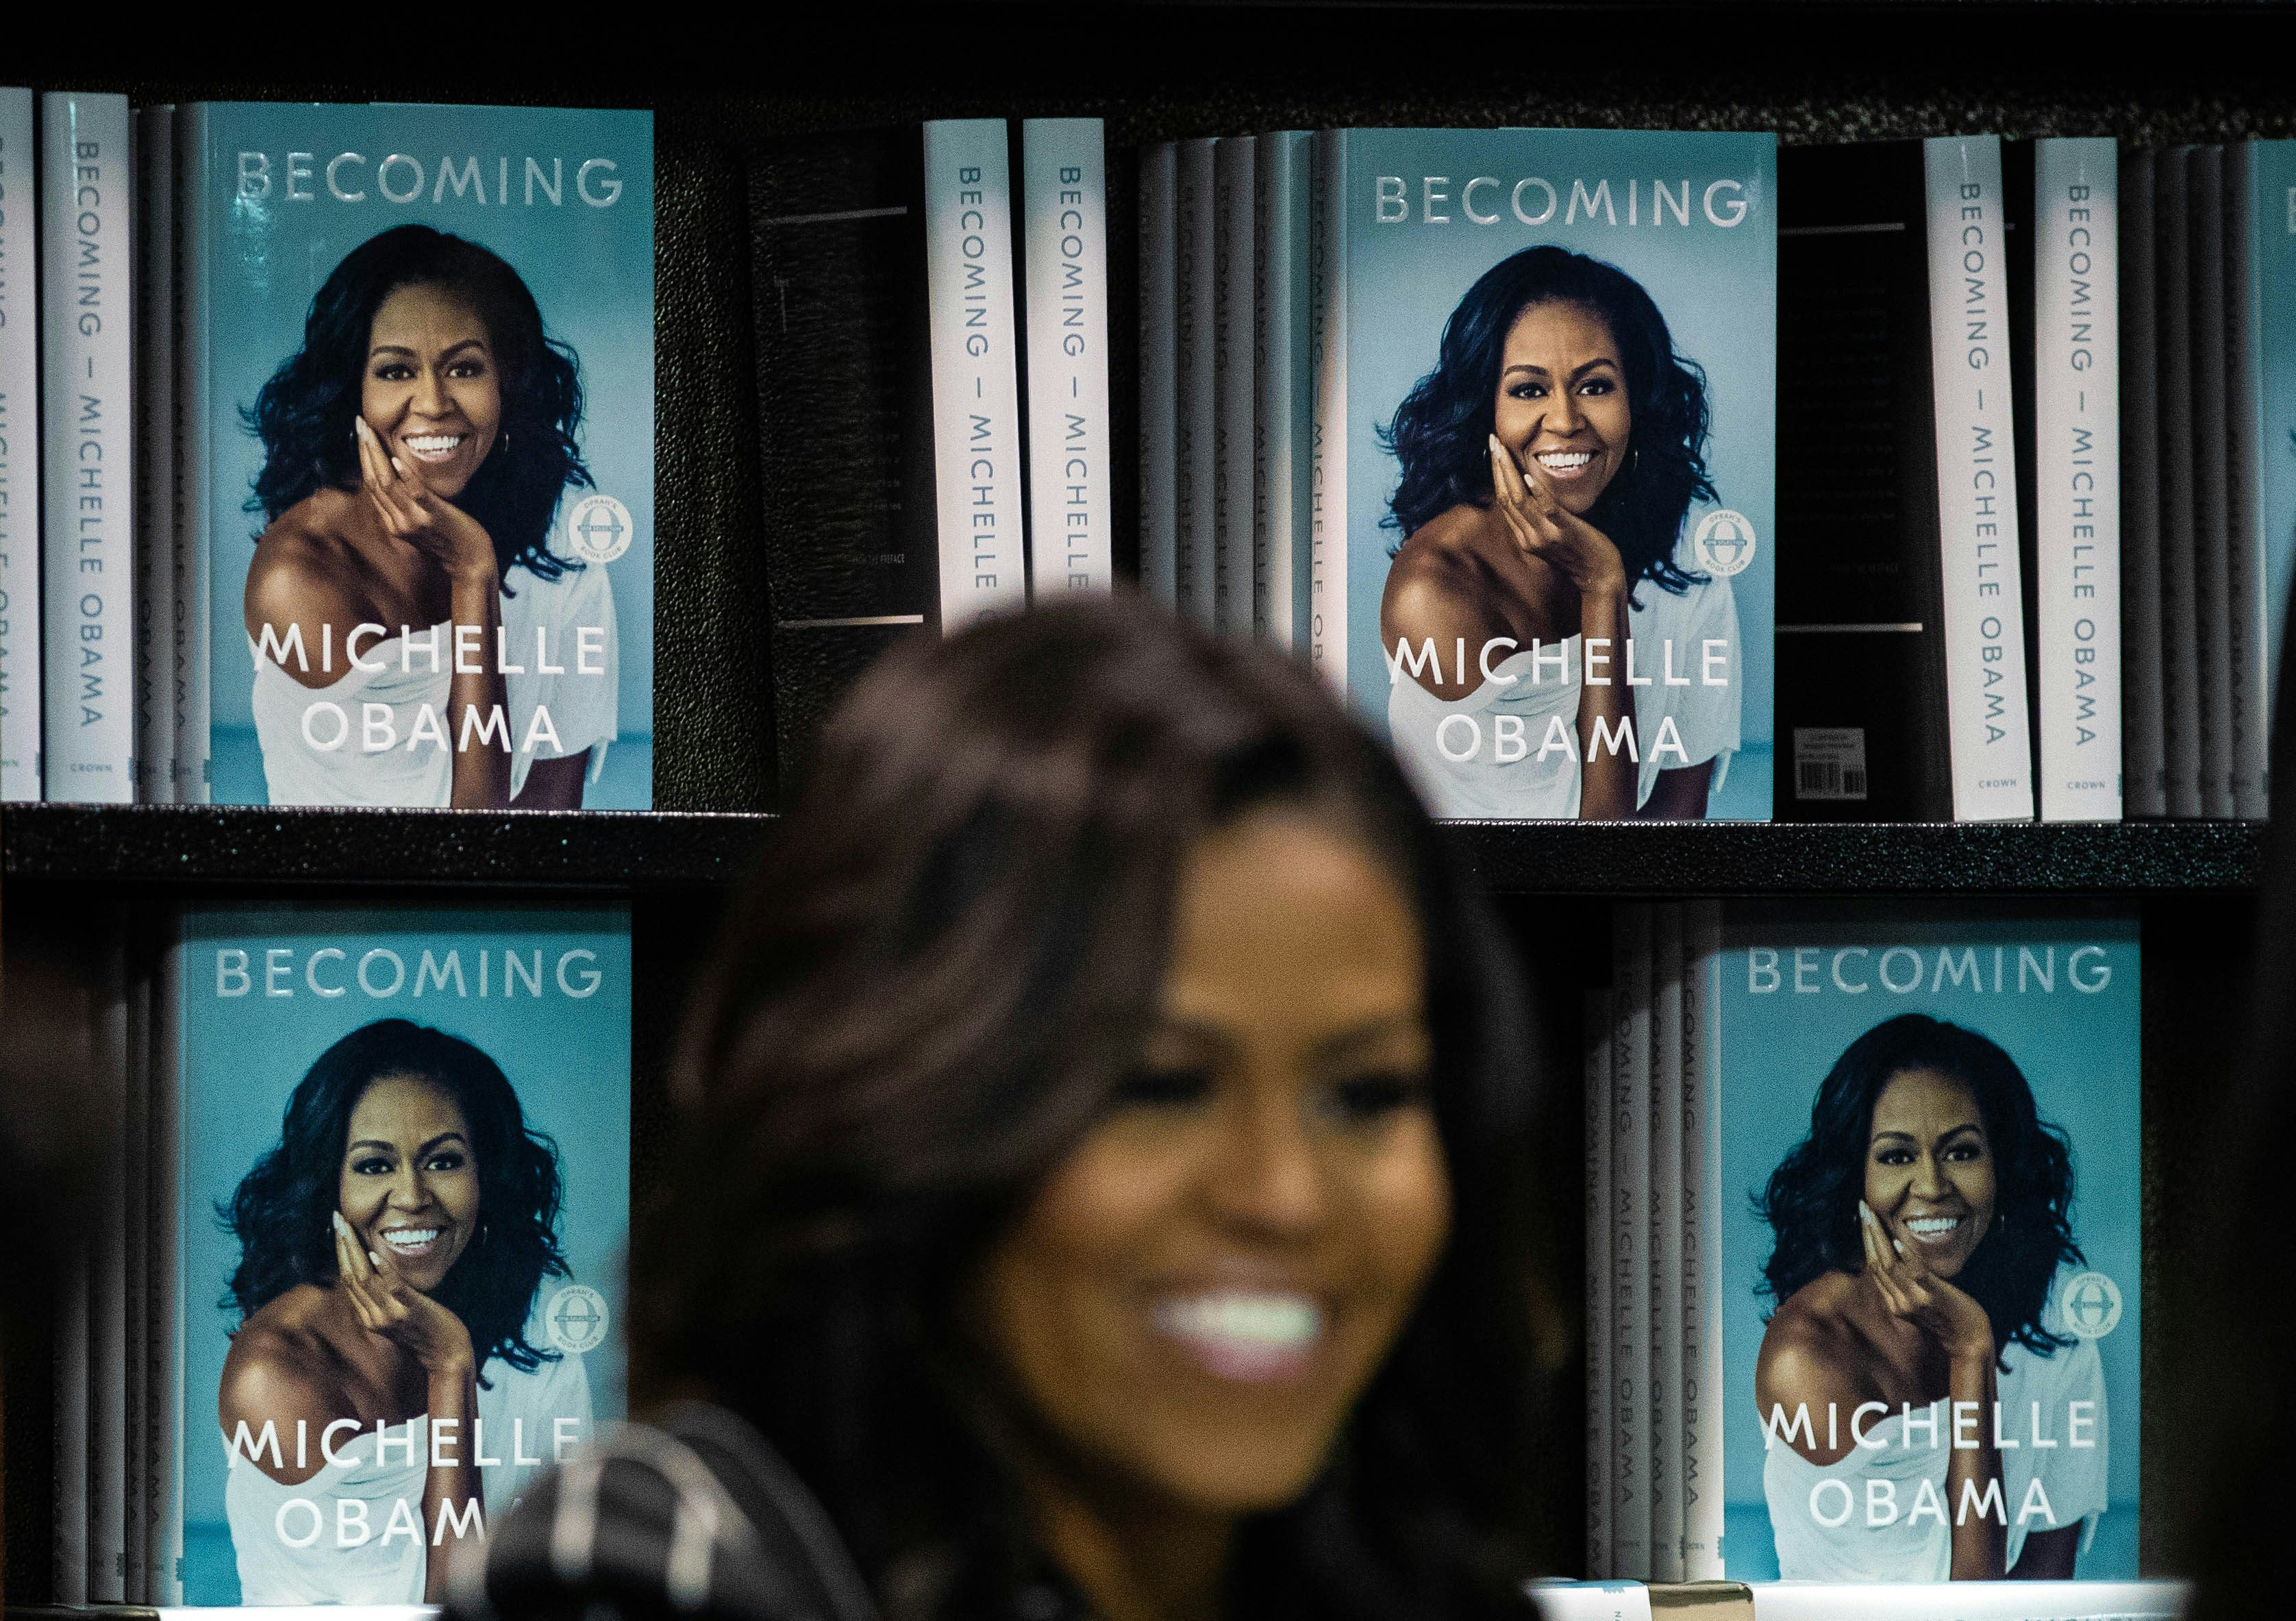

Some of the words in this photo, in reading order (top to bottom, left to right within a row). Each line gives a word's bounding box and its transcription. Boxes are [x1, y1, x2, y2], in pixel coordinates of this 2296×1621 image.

[76, 140, 102, 338] BECOMING
[237, 151, 623, 207] BECOMING
[1375, 175, 1749, 227] BECOMING
[959, 166, 988, 358] BECOMING
[1059, 166, 1085, 356] BECOMING
[1960, 182, 1989, 371] BECOMING
[2069, 184, 2093, 372] BECOMING
[79, 394, 103, 575] MICHELLE
[969, 414, 997, 589] MICHELLE
[1064, 414, 1089, 589] MICHELLE
[1314, 422, 1323, 593] MICHELLE
[1972, 425, 2000, 597] MICHELLE
[2072, 428, 2095, 599] MICHELLE
[79, 594, 103, 728] OBAMA
[253, 622, 606, 676] MICHELLE
[1389, 636, 1729, 686] MICHELLE
[1980, 616, 2007, 745] OBAMA
[2074, 618, 2097, 746] OBAMA
[70, 764, 112, 773] CROWN
[301, 701, 564, 753] OBAMA
[1436, 713, 1690, 763] OBAMA
[1978, 778, 2017, 789] CROWN
[2067, 781, 2106, 790] CROWN
[216, 948, 602, 998] BECOMING
[1748, 945, 2112, 993] BECOMING
[1620, 1188, 1633, 1357] MICHELLE
[1685, 1187, 1697, 1358] MICHELLE
[227, 1418, 580, 1469] MICHELLE
[1621, 1378, 1634, 1504] OBAMA
[1651, 1379, 1663, 1506] OBAMA
[1686, 1378, 1699, 1506] OBAMA
[1764, 1401, 2096, 1450] MICHELLE
[275, 1497, 488, 1548] OBAM
[1809, 1478, 2056, 1528] OBAMA
